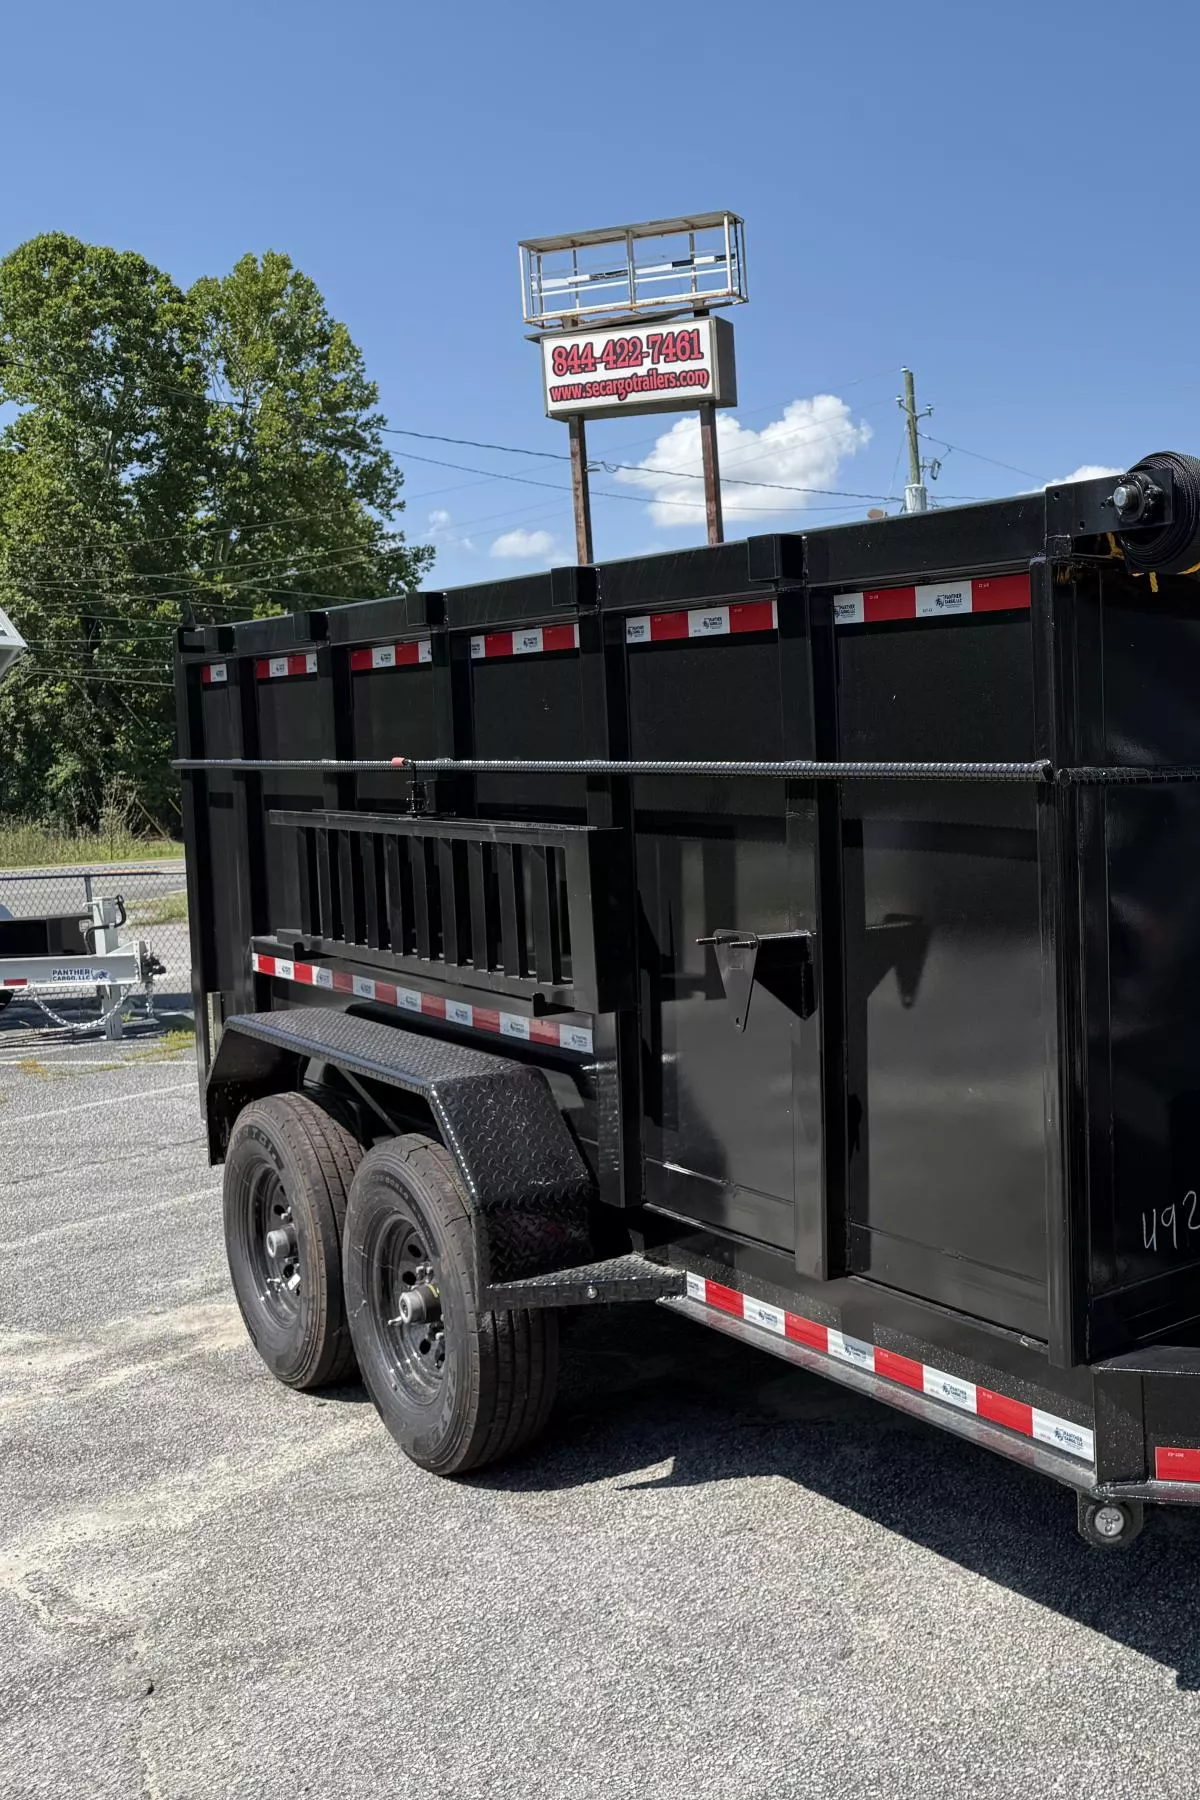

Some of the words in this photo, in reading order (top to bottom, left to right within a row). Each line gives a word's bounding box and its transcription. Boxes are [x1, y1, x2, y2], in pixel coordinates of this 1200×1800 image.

[552, 328, 704, 377] 844-422-7461
[549, 367, 710, 402] www.secargotrailers.com
[52, 968, 90, 976] PANTHER
